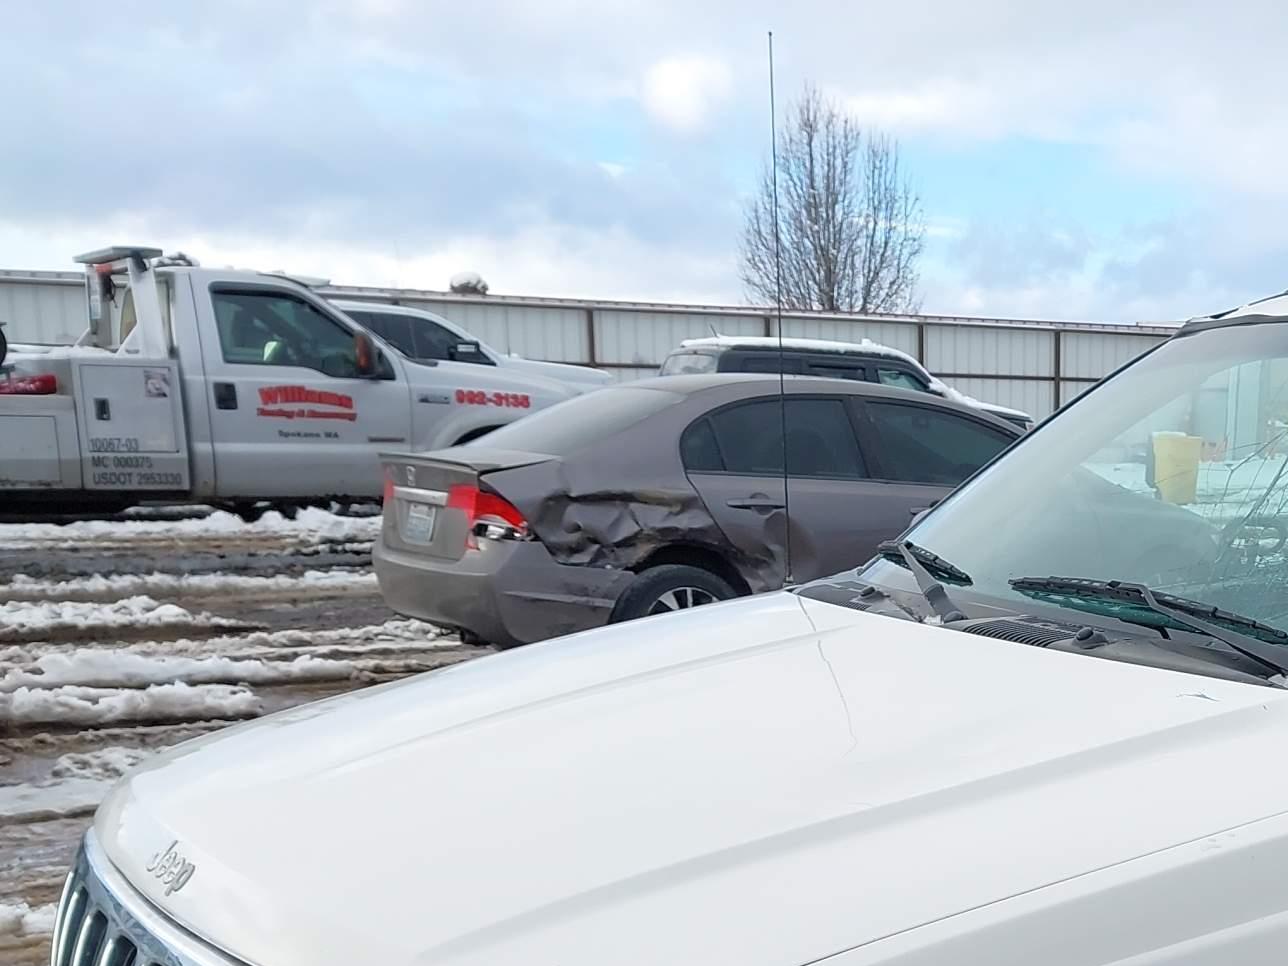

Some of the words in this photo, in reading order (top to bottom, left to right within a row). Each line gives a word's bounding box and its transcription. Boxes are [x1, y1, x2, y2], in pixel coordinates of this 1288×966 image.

[258, 385, 353, 409] Williams
[92, 456, 110, 468] MC
[93, 472, 133, 485] USDOT
